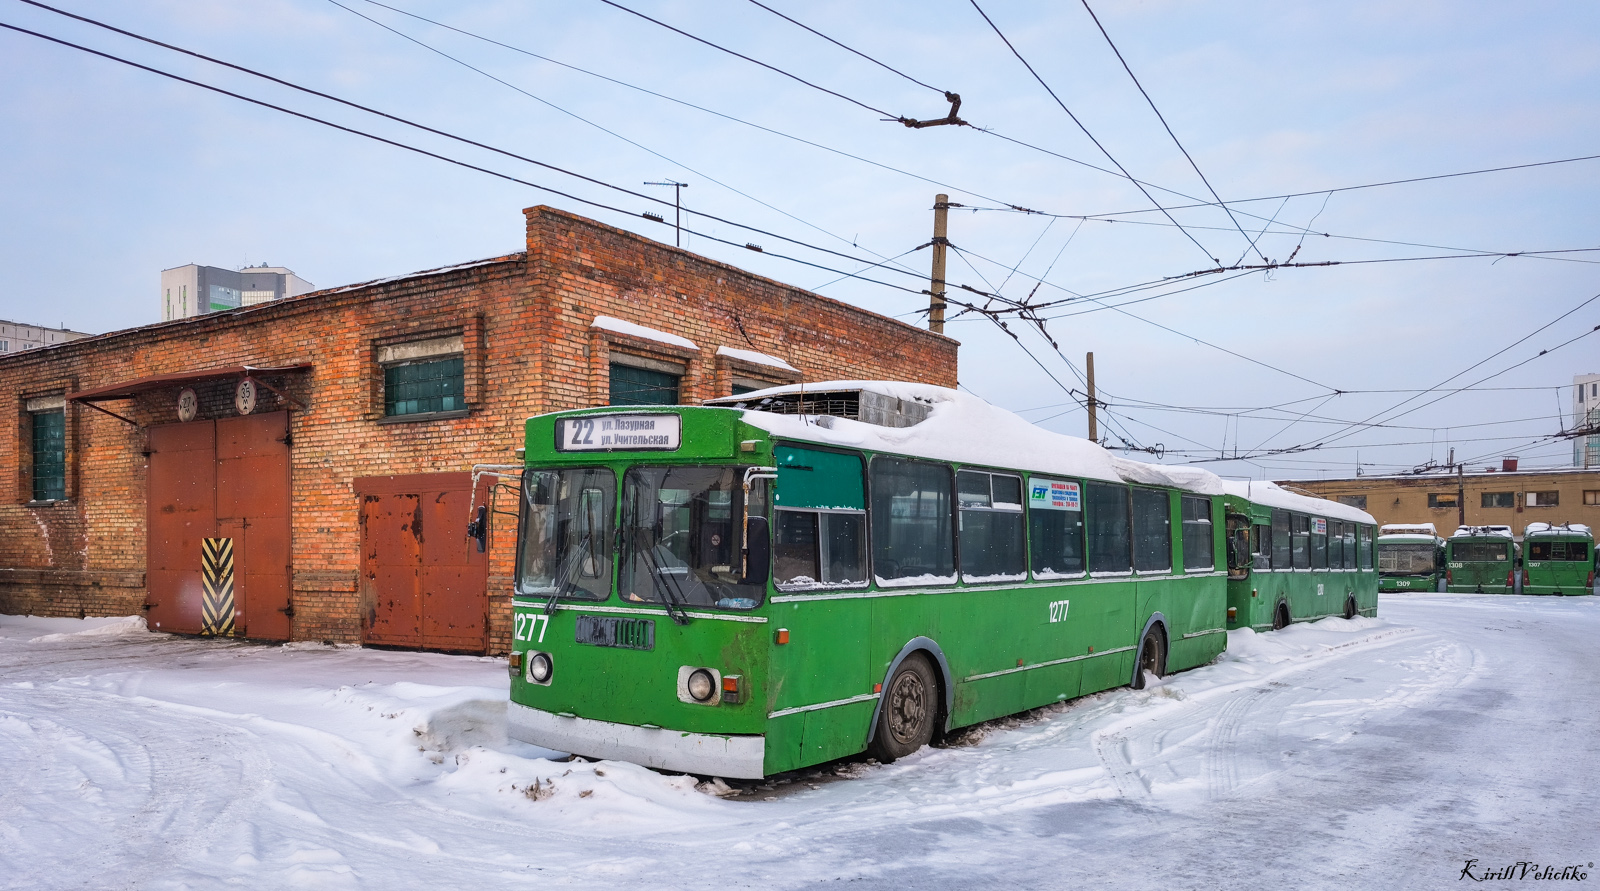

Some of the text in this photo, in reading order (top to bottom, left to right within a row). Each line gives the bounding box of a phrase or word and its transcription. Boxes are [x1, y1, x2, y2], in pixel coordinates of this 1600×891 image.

[571, 419, 595, 445] 22
[601, 418, 655, 432] ул. Лазурная
[601, 433, 669, 446] ул. Учительская
[1049, 599, 1069, 623] 1277
[513, 612, 549, 643] 1277
